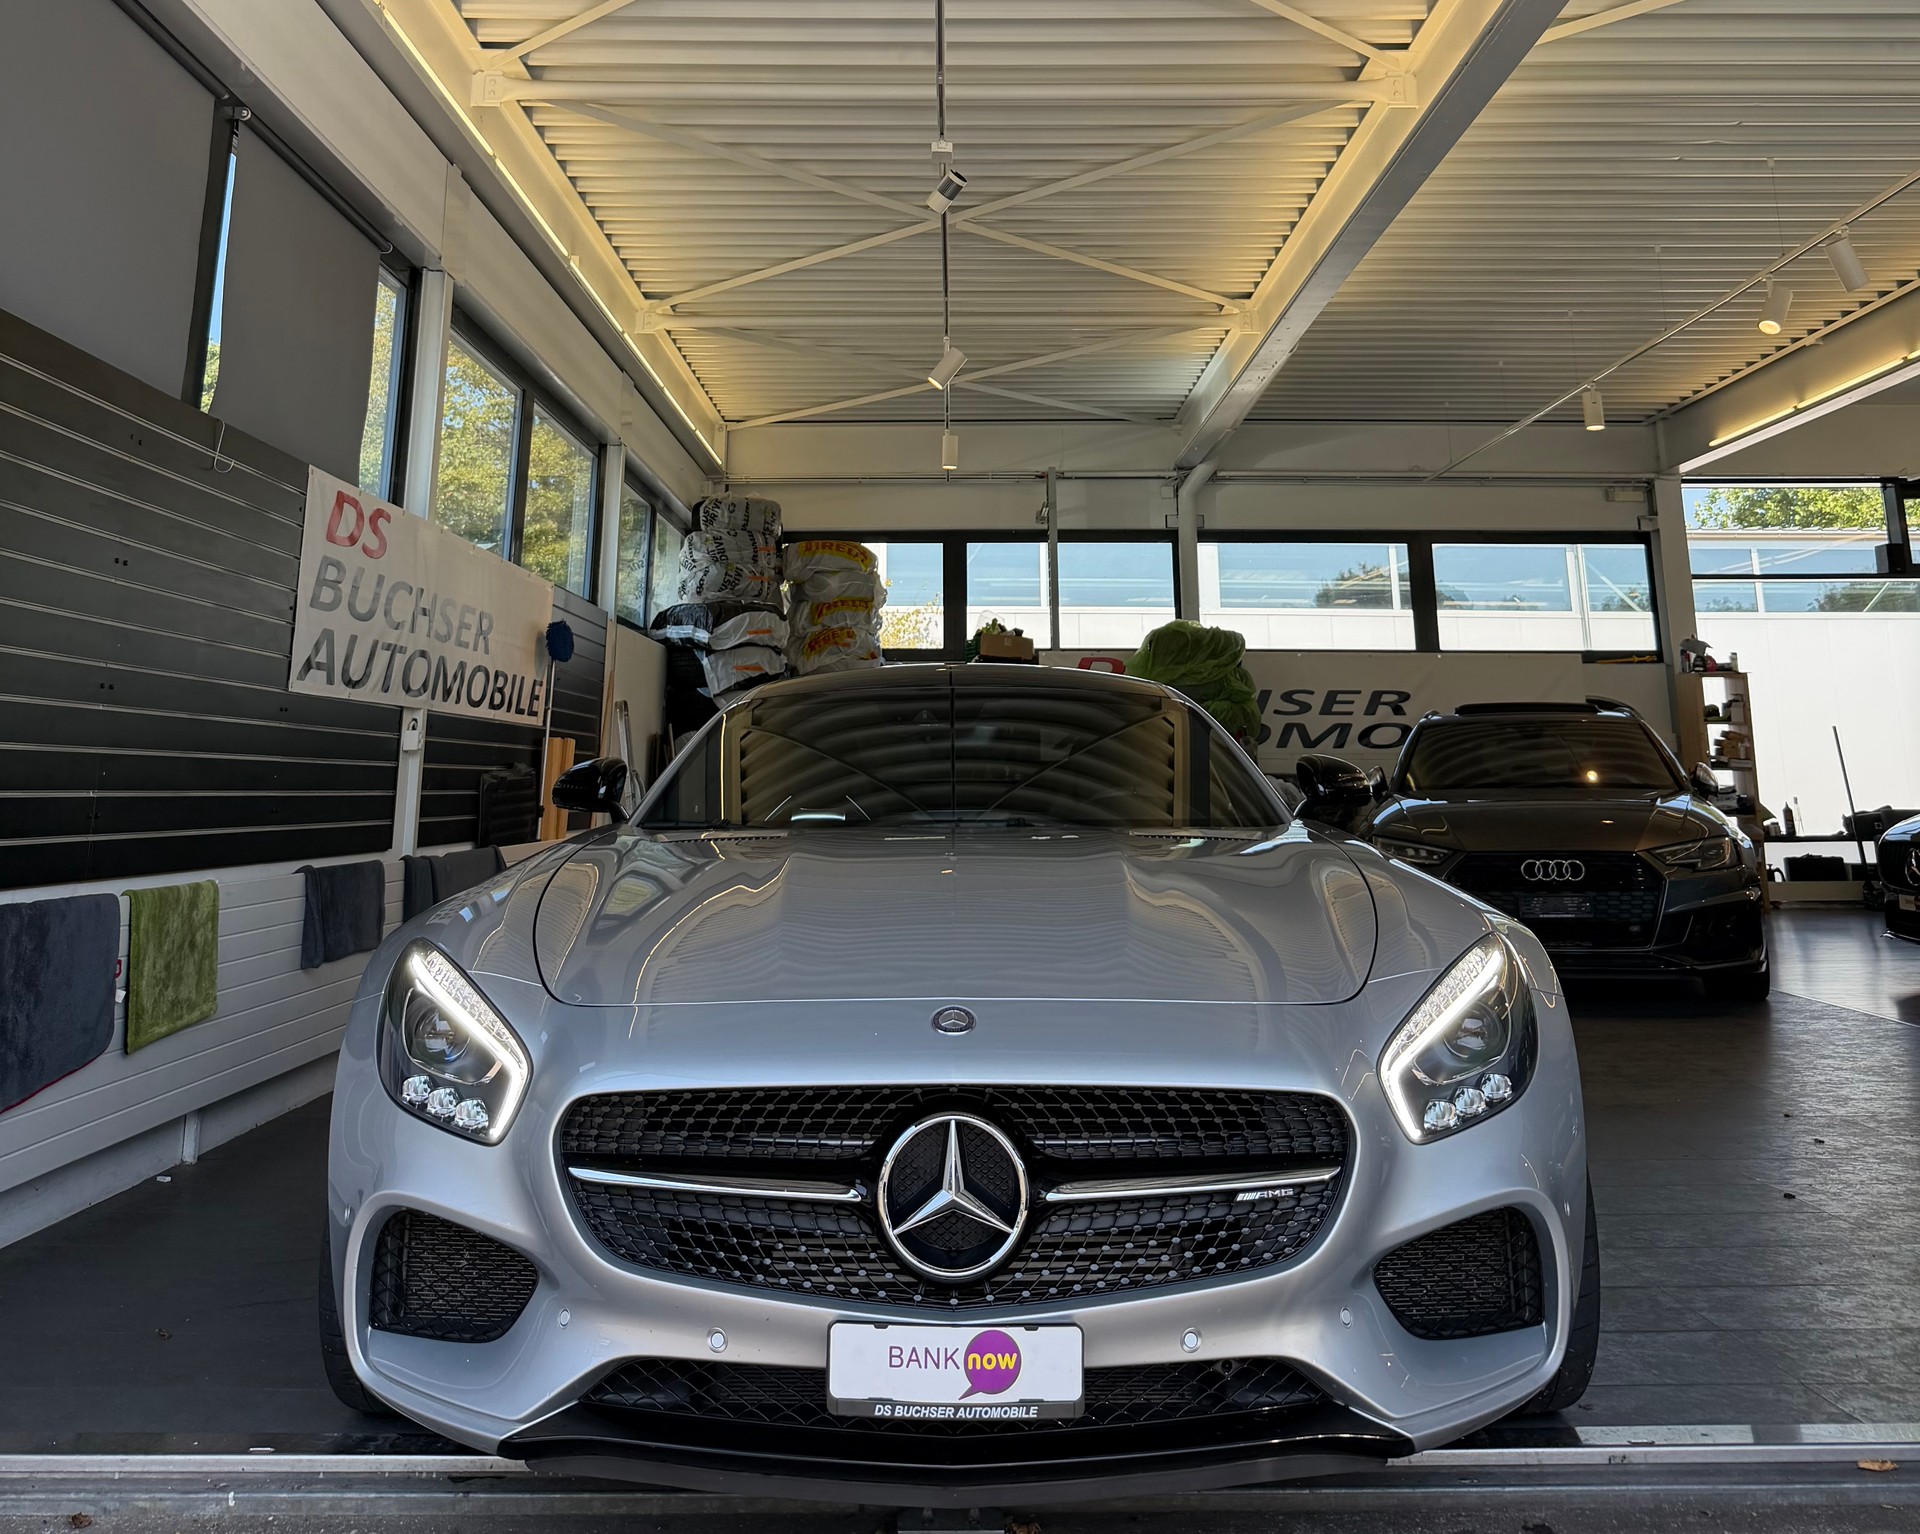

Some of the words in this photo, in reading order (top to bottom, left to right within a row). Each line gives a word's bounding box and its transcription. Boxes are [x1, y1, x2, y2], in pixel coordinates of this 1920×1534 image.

[326, 490, 391, 560] DS
[309, 555, 495, 655] BUCHSER
[296, 628, 544, 718] AUTOMOBILE
[1255, 1188, 1294, 1200] AMG
[888, 1345, 960, 1370] BANK
[967, 1352, 1018, 1371] now
[874, 1404, 892, 1417] DS
[894, 1405, 954, 1418] BUCHSER
[956, 1406, 1039, 1419] AUTOMOBILE
